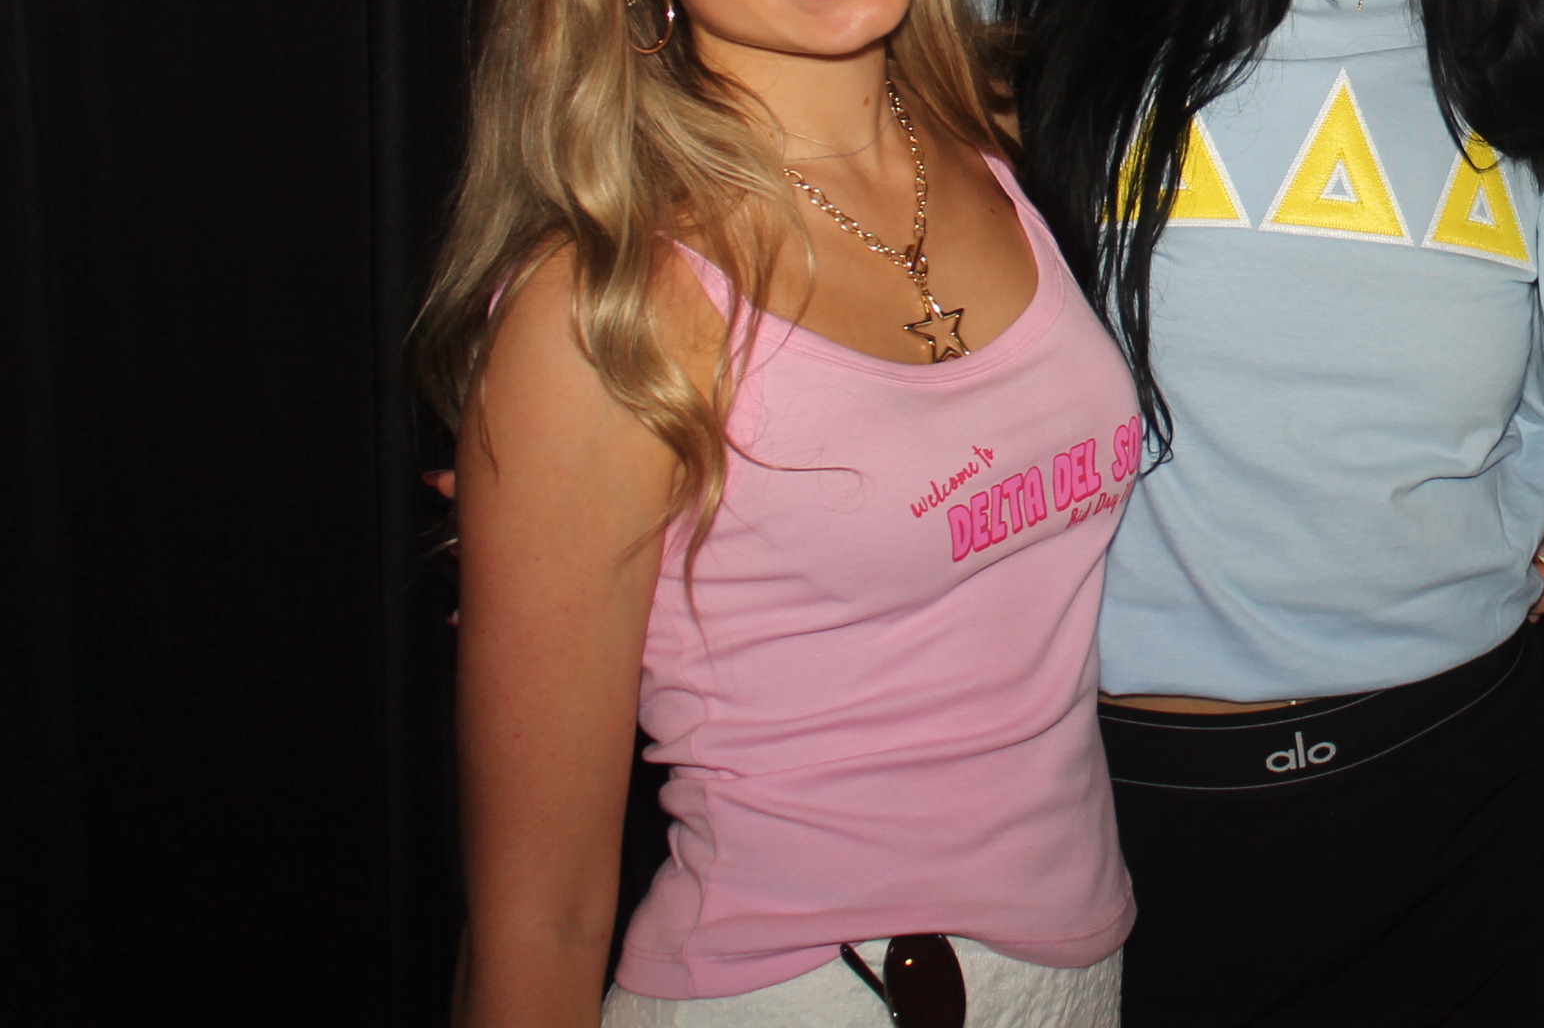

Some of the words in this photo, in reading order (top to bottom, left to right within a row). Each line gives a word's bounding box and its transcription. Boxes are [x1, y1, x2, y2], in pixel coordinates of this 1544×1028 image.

[910, 460, 980, 518] welcome
[971, 445, 994, 468] to
[947, 466, 1047, 562] DELTA
[1053, 438, 1101, 512] DEL
[1111, 411, 1142, 482] SO
[1066, 501, 1092, 529] Bid
[1093, 492, 1119, 515] Day
[1265, 731, 1337, 772] alo
